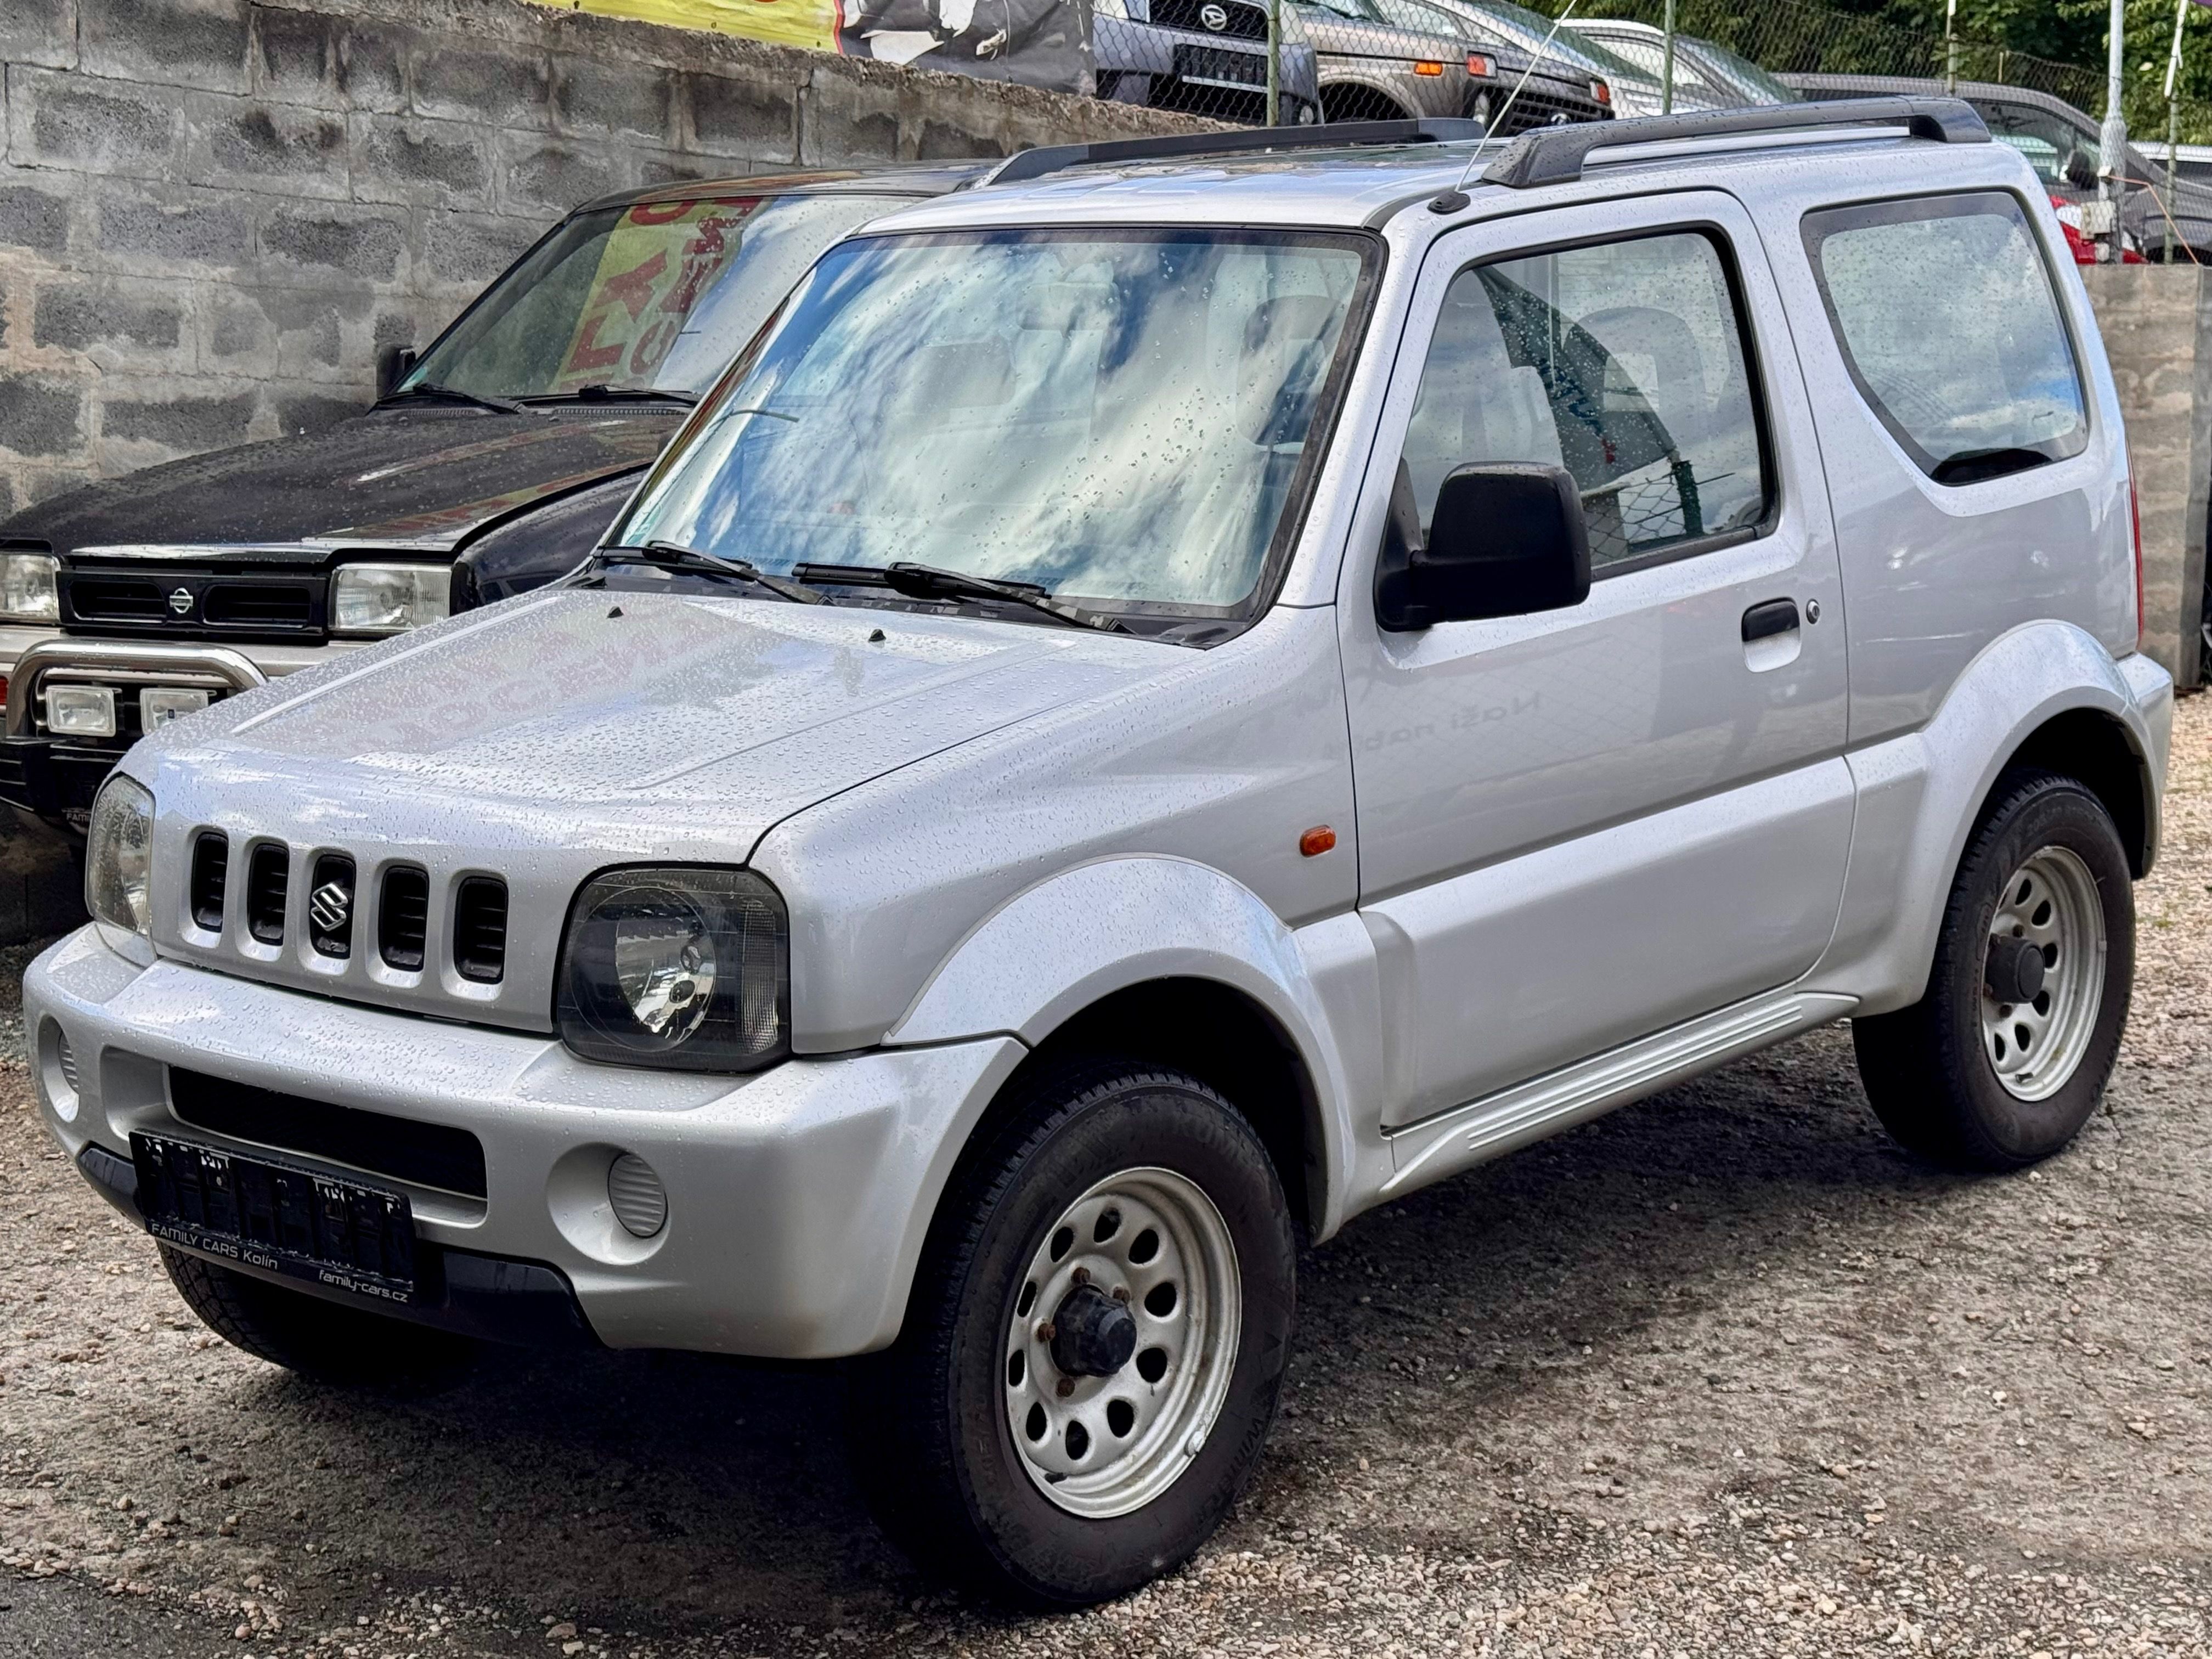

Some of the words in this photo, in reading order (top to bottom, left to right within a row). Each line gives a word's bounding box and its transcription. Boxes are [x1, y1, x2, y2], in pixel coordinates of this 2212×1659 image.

[151, 1222, 196, 1246] FAMILY
[202, 1238, 238, 1258] CARS
[243, 1249, 278, 1270] Kolín
[319, 1268, 408, 1302] family-cars.cz
